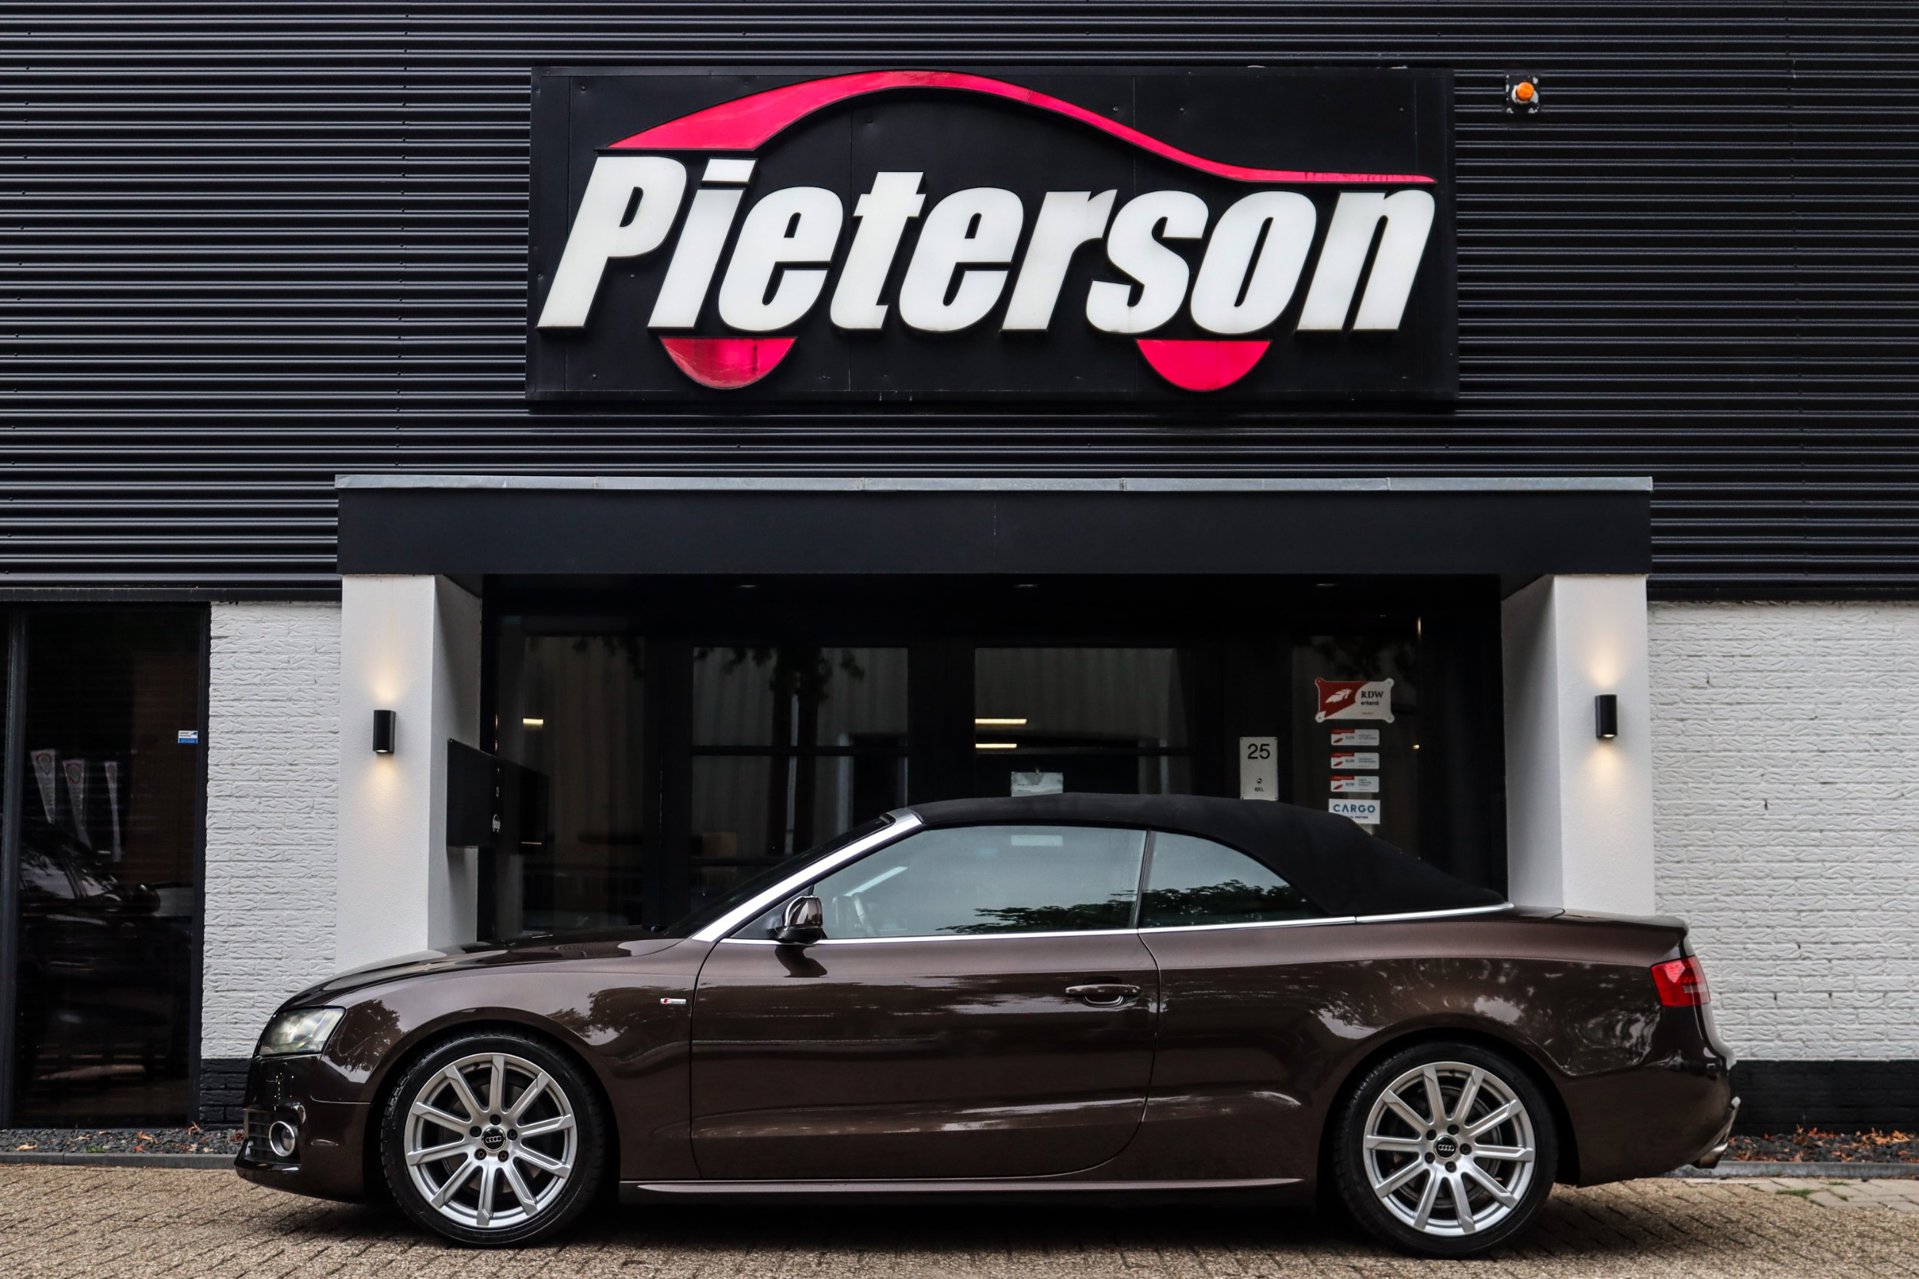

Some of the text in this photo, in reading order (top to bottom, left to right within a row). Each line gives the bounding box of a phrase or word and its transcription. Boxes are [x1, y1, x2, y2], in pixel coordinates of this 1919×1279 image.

[537, 156, 1436, 334] Pieterson
[1361, 690, 1384, 699] RDW
[1247, 743, 1270, 760] 25
[1332, 803, 1376, 813] CARGO
